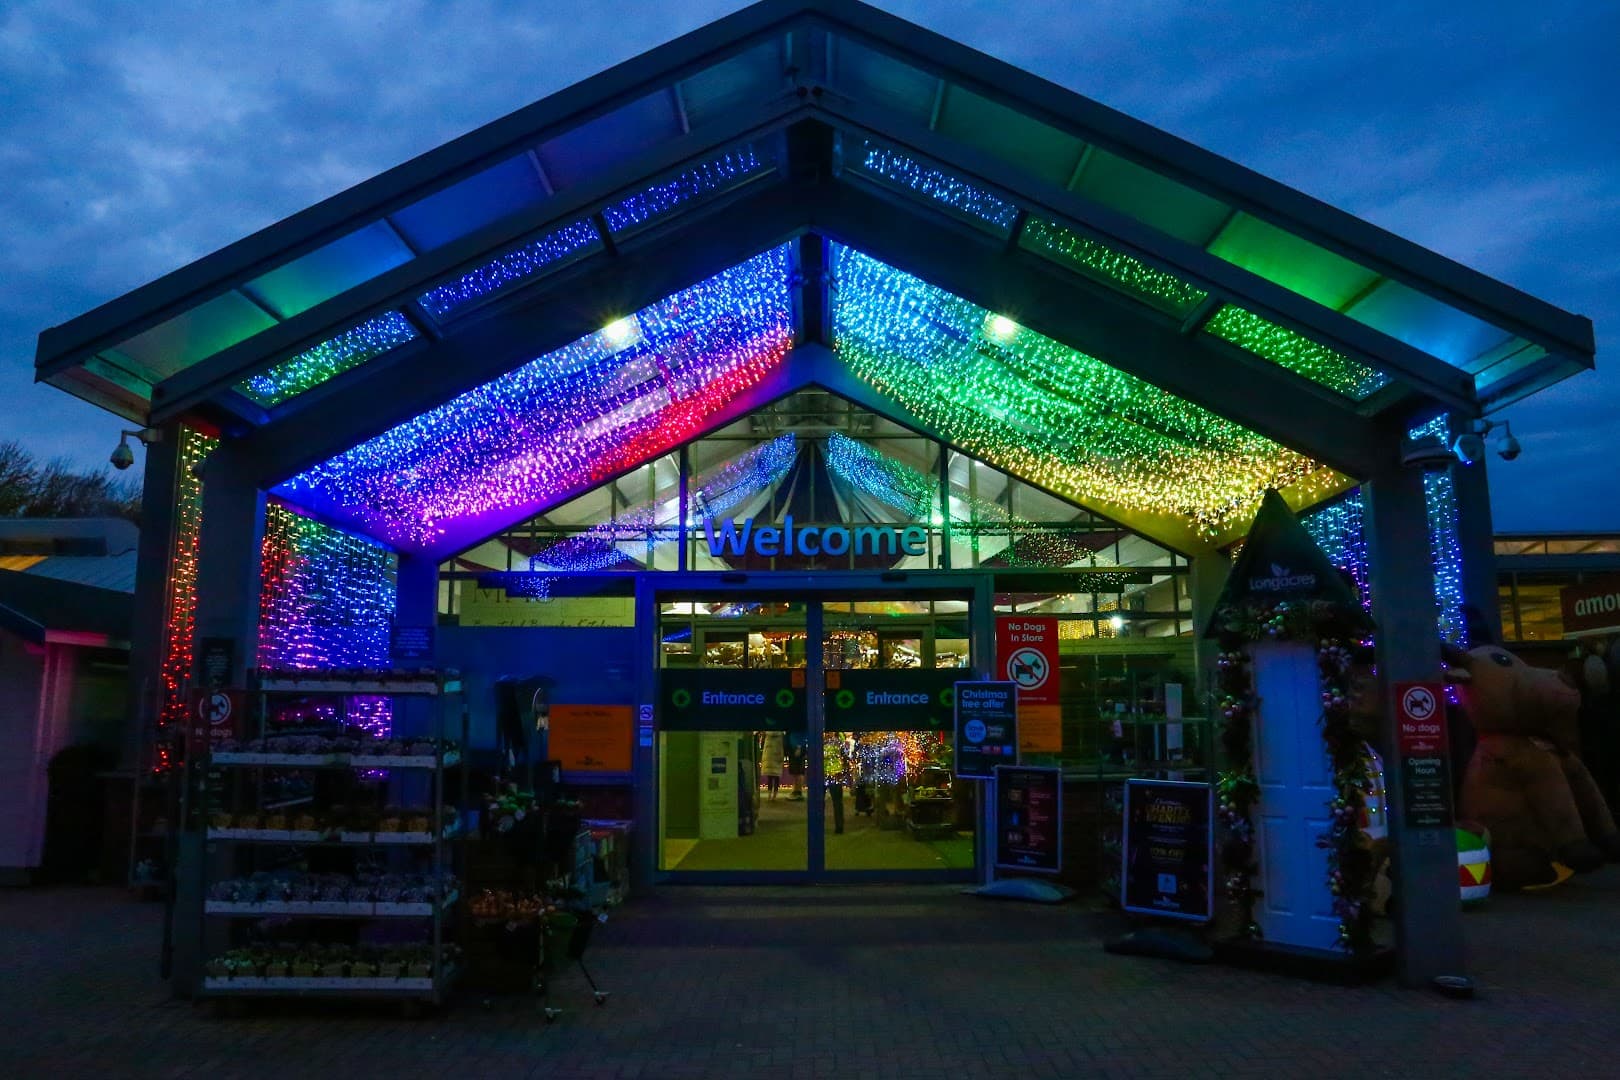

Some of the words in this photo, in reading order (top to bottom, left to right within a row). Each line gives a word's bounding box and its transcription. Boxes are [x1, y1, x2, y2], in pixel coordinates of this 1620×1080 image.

[703, 515, 927, 557] Welcome
[1249, 574, 1317, 591] Longacres
[1008, 623, 1021, 631] No
[1023, 623, 1046, 632] Dogs
[1011, 634, 1019, 642] In
[1021, 634, 1044, 642] Store
[702, 691, 766, 705] Entrance
[866, 691, 929, 705] Entrance
[962, 689, 1008, 699] Christmas
[982, 699, 1005, 709] offer
[1402, 724, 1416, 732] No
[1418, 724, 1440, 734] dogs
